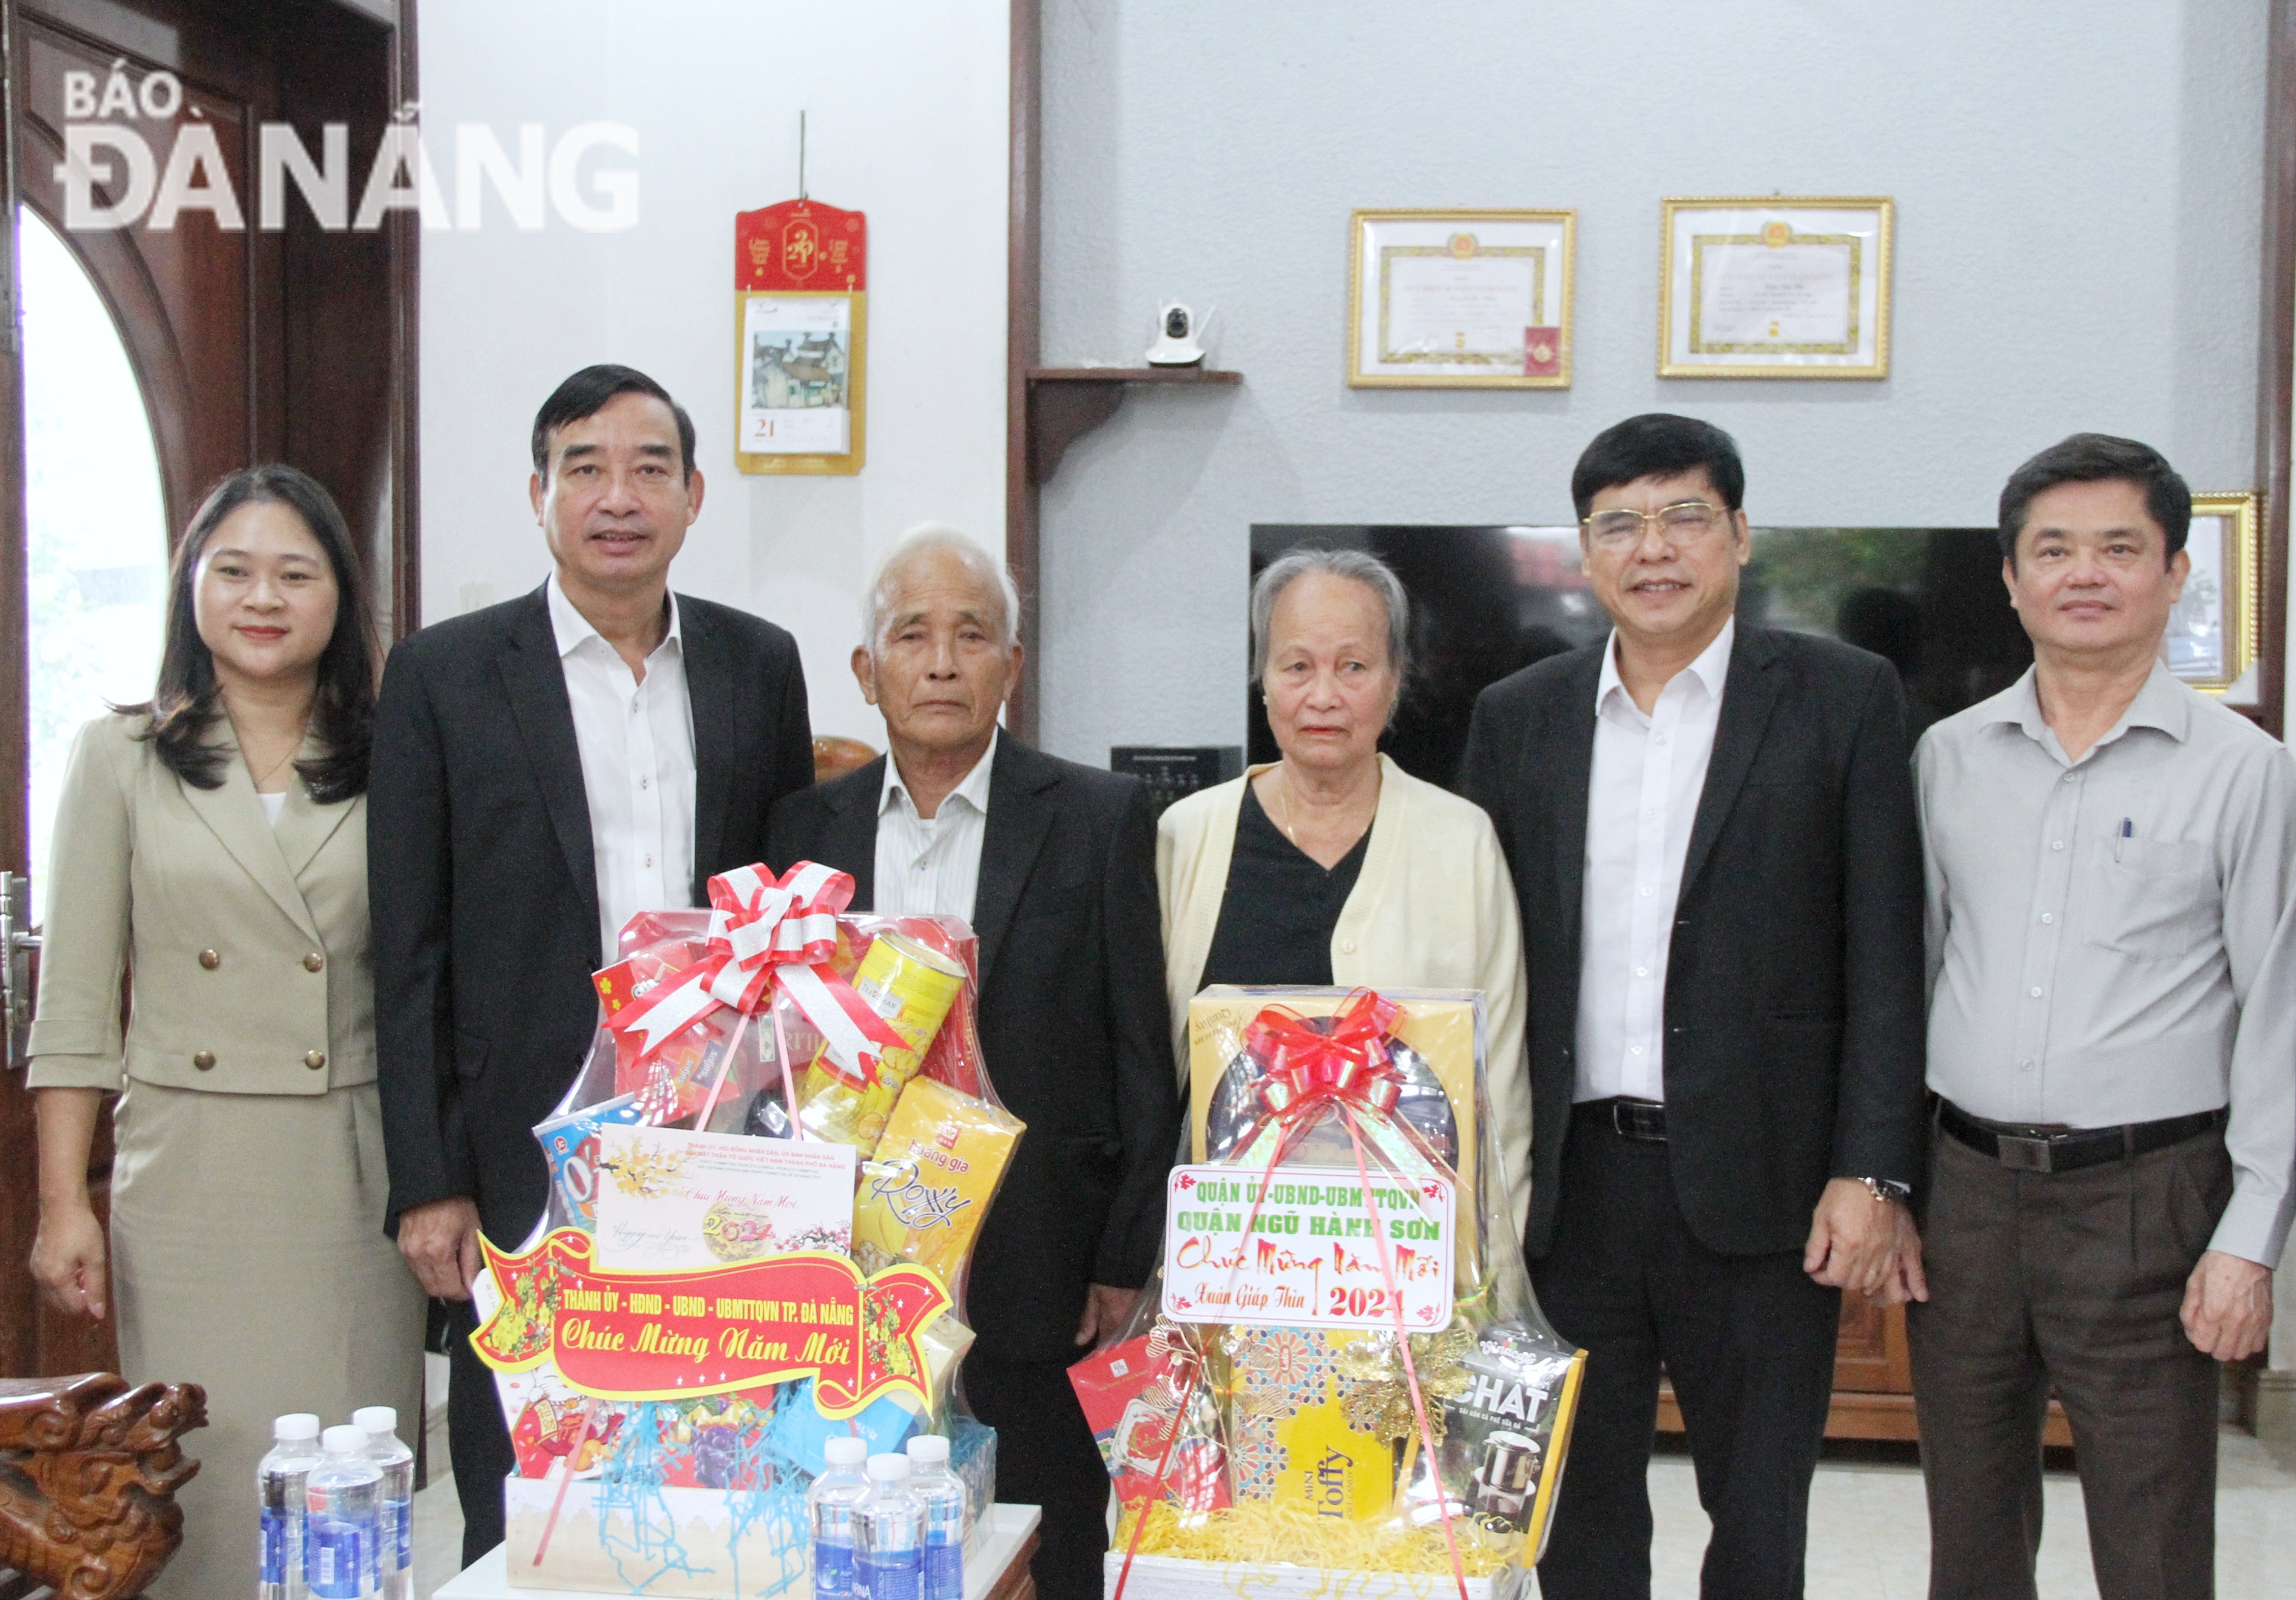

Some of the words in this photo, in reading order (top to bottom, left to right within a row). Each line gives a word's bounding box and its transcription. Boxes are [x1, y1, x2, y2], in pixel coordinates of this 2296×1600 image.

[755, 418, 774, 437] 21
[678, 1059, 694, 1085] sugus
[702, 1050, 718, 1077] sugus
[1197, 1177, 1241, 1207] QUẬN
[703, 1215, 772, 1241] 2024
[1178, 1207, 1242, 1236] QUẬN
[1250, 1210, 1300, 1235] NGŨ
[1309, 1211, 1381, 1238] HÀNH
[1389, 1215, 1441, 1240] SƠN
[563, 1287, 601, 1311] THÀNH
[604, 1284, 619, 1312] ỦY
[630, 1293, 662, 1315] HĐND
[673, 1296, 706, 1318] UBND
[716, 1298, 780, 1323] UBMTTQVN
[783, 1302, 798, 1323] TP.
[801, 1299, 817, 1324] ĐÀ
[820, 1297, 854, 1326] NẴNG
[1194, 1281, 1232, 1305] Xuân
[1235, 1283, 1269, 1311] Giáp
[1274, 1284, 1306, 1308] Thìn
[562, 1317, 626, 1352] Chúc
[630, 1322, 711, 1364] Mừng
[719, 1327, 790, 1361] Năm
[795, 1332, 851, 1365] Mới
[1305, 1470, 1313, 1500] MINI
[1317, 1444, 1354, 1522] Toffy
